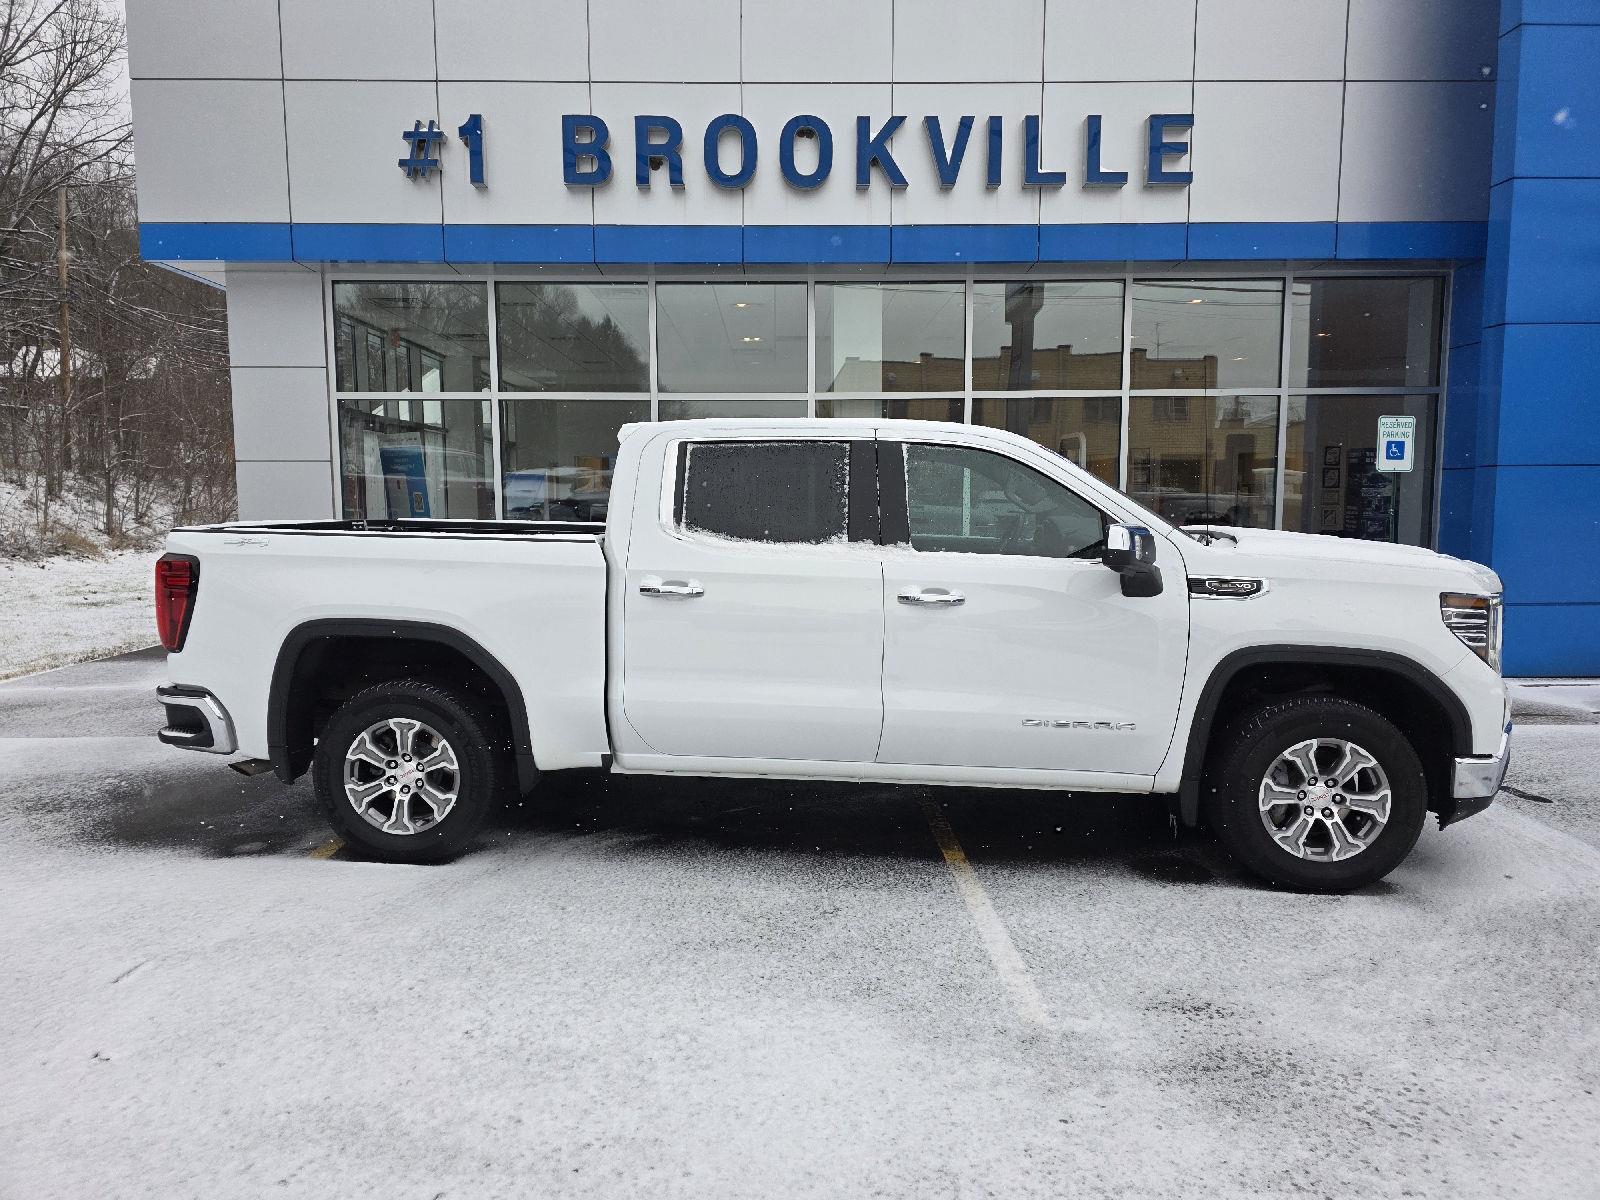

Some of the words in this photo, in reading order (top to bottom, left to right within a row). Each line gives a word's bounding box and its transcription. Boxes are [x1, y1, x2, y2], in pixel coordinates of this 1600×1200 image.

[398, 114, 488, 190] #1
[562, 113, 1195, 190] BROOKVILLE
[1380, 421, 1413, 429] RESERVED
[1382, 430, 1411, 439] PARKING
[1021, 719, 1136, 731] SIERRA
